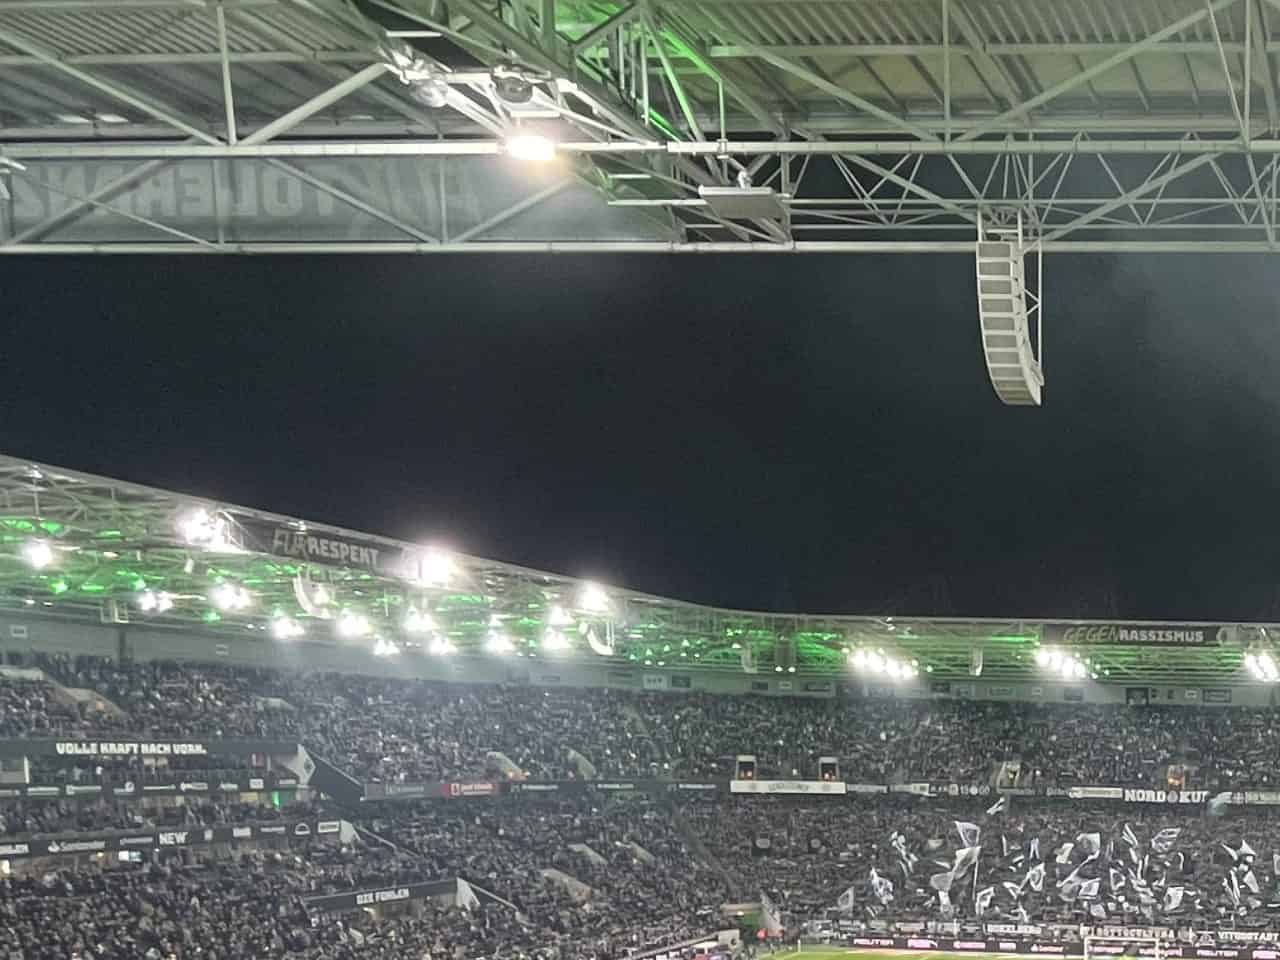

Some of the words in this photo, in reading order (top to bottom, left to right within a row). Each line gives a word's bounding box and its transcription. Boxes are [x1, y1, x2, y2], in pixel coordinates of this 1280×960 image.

[308, 535, 379, 567] RESPEKT
[1119, 629, 1203, 642] RASSISMUS
[56, 742, 97, 755] VOLLE
[100, 742, 139, 755] KRAFT
[141, 743, 171, 755] NACH
[1125, 790, 1166, 803] NORD
[159, 831, 189, 845] NEW
